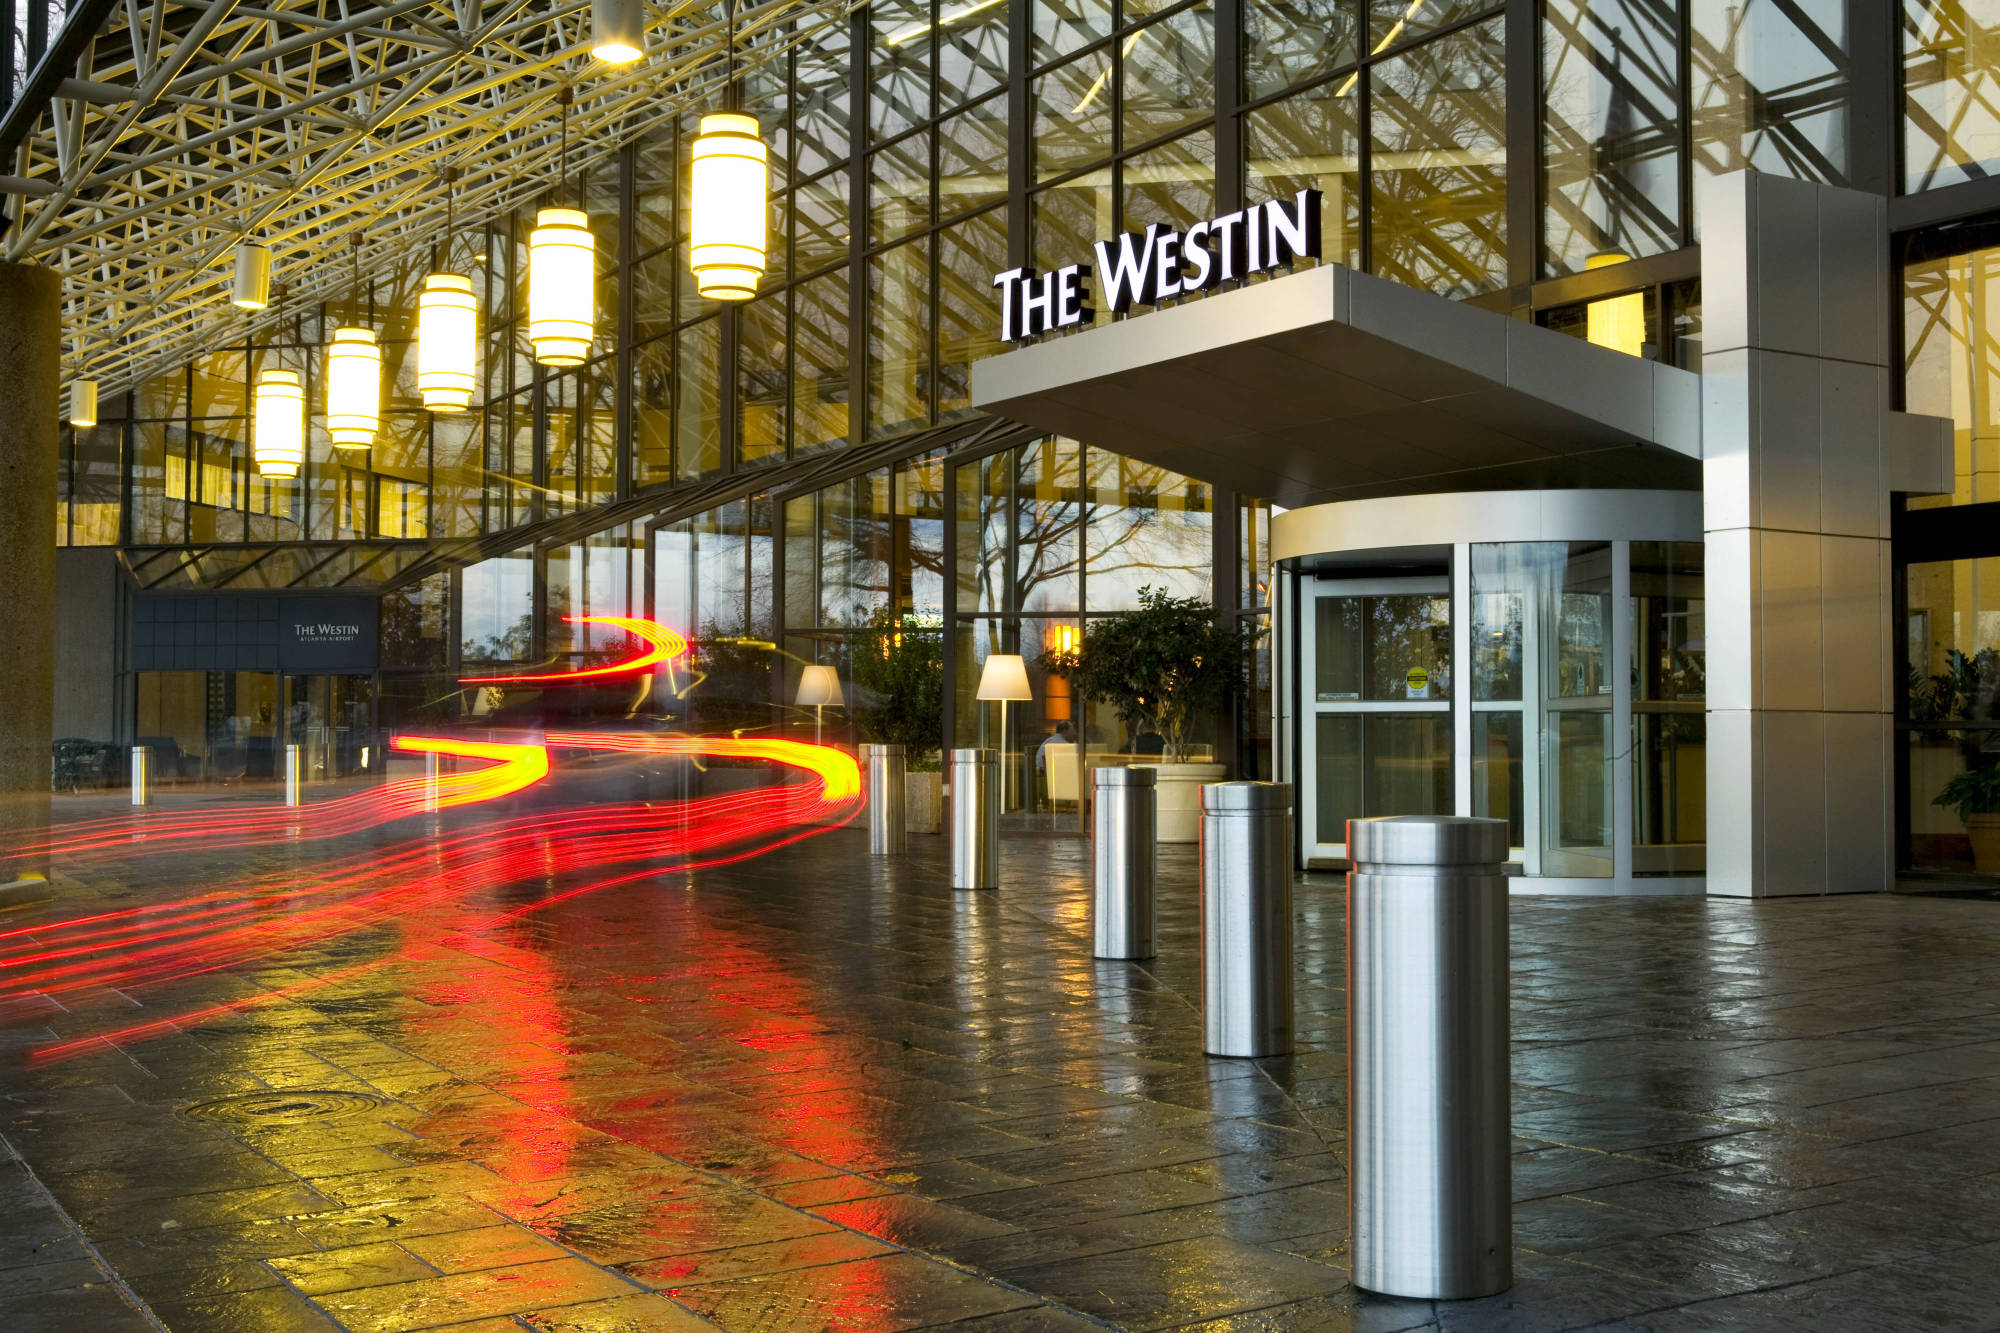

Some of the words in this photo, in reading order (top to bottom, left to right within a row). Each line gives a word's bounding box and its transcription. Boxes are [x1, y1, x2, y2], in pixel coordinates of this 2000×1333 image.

[994, 264, 1084, 342] THE
[1093, 189, 1311, 312] WESTIN
[294, 624, 315, 635] THE
[318, 624, 359, 635] WESTIN
